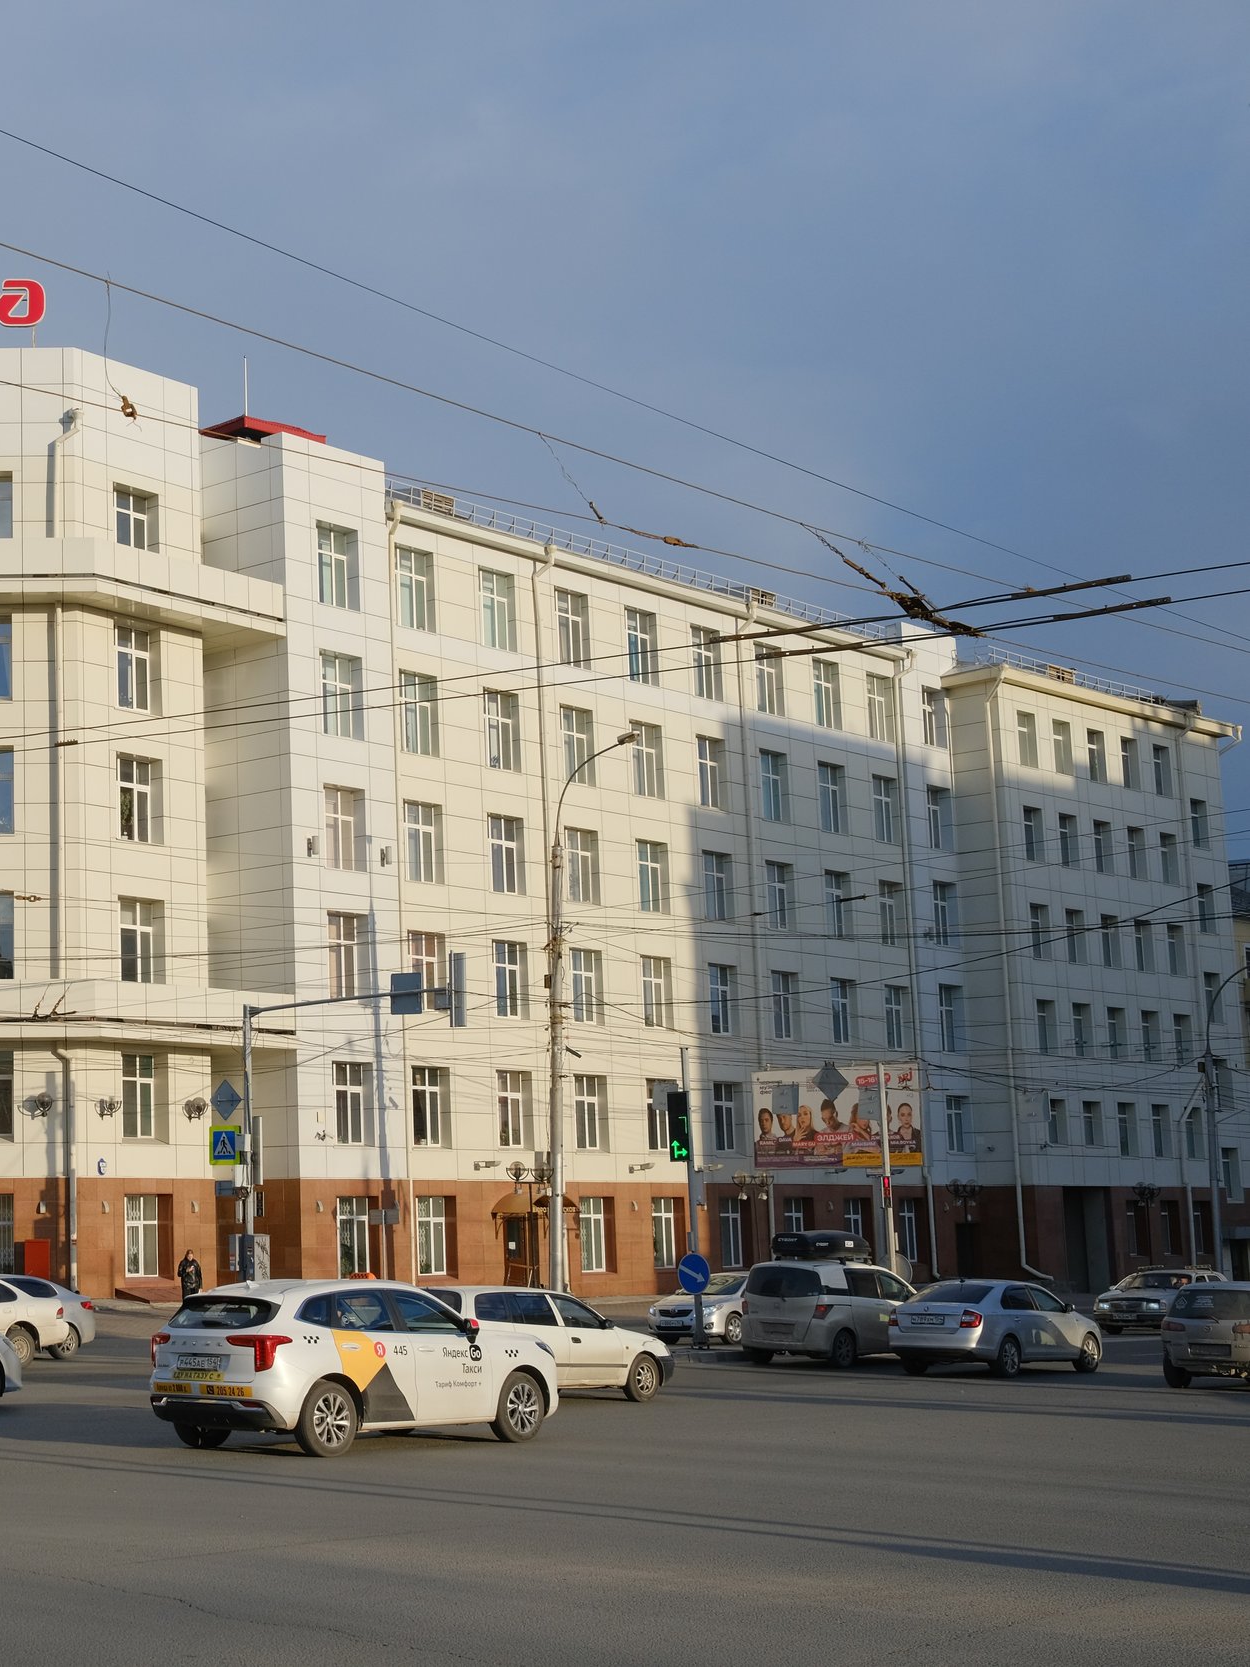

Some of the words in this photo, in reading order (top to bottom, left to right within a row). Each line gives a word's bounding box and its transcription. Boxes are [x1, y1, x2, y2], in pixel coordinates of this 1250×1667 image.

[817, 1133, 854, 1142] ЭЛДЖЕЙ
[393, 1346, 408, 1356] 445
[442, 1347, 468, 1358] Яндекс
[470, 1348, 481, 1359] Go
[462, 1363, 482, 1374] Такси
[453, 1379, 477, 1388] Комфорт
[217, 1386, 227, 1396] 205
[228, 1387, 236, 1396] 24
[237, 1387, 245, 1397] 26
